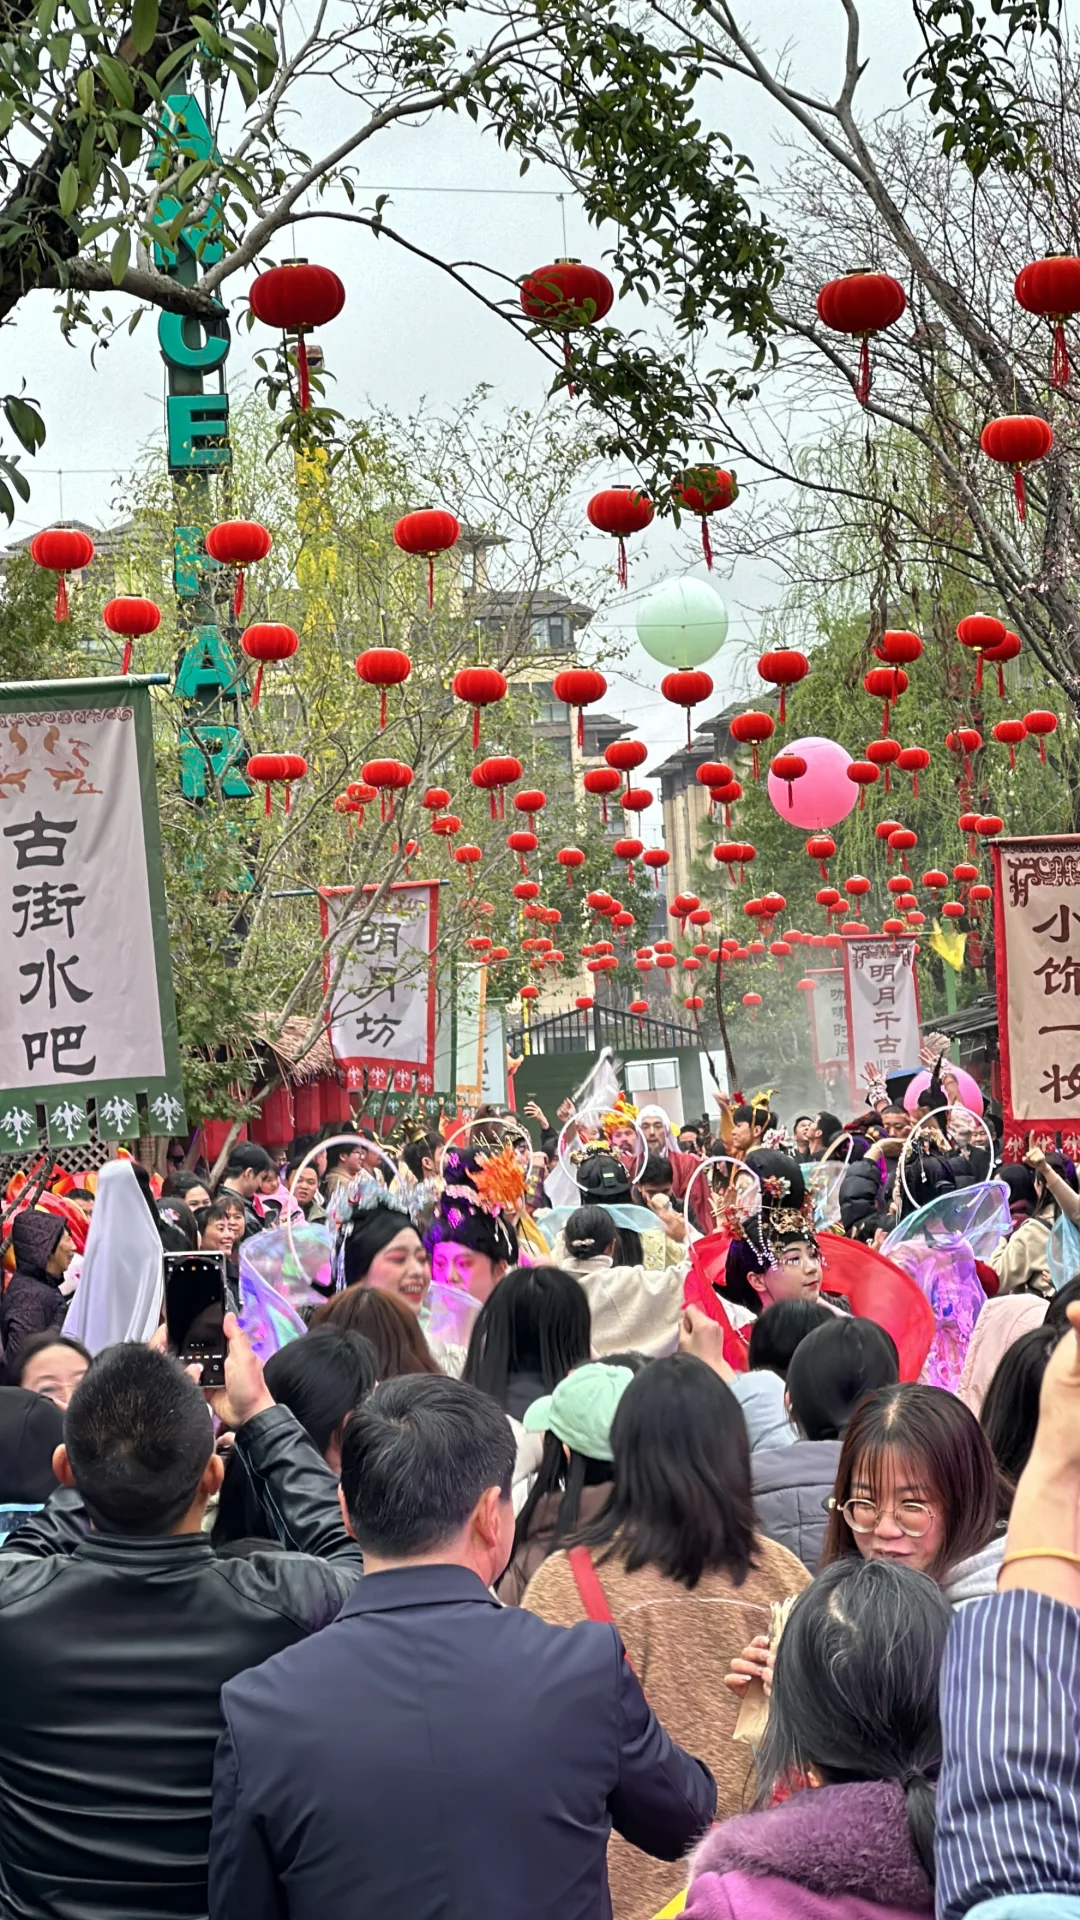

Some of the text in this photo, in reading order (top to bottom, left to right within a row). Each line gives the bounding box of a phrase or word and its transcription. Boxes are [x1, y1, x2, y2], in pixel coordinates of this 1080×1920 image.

[147, 12, 232, 467] ANCE
[3, 810, 96, 1076] 古街水吧
[356, 922, 402, 1048] 明月坊
